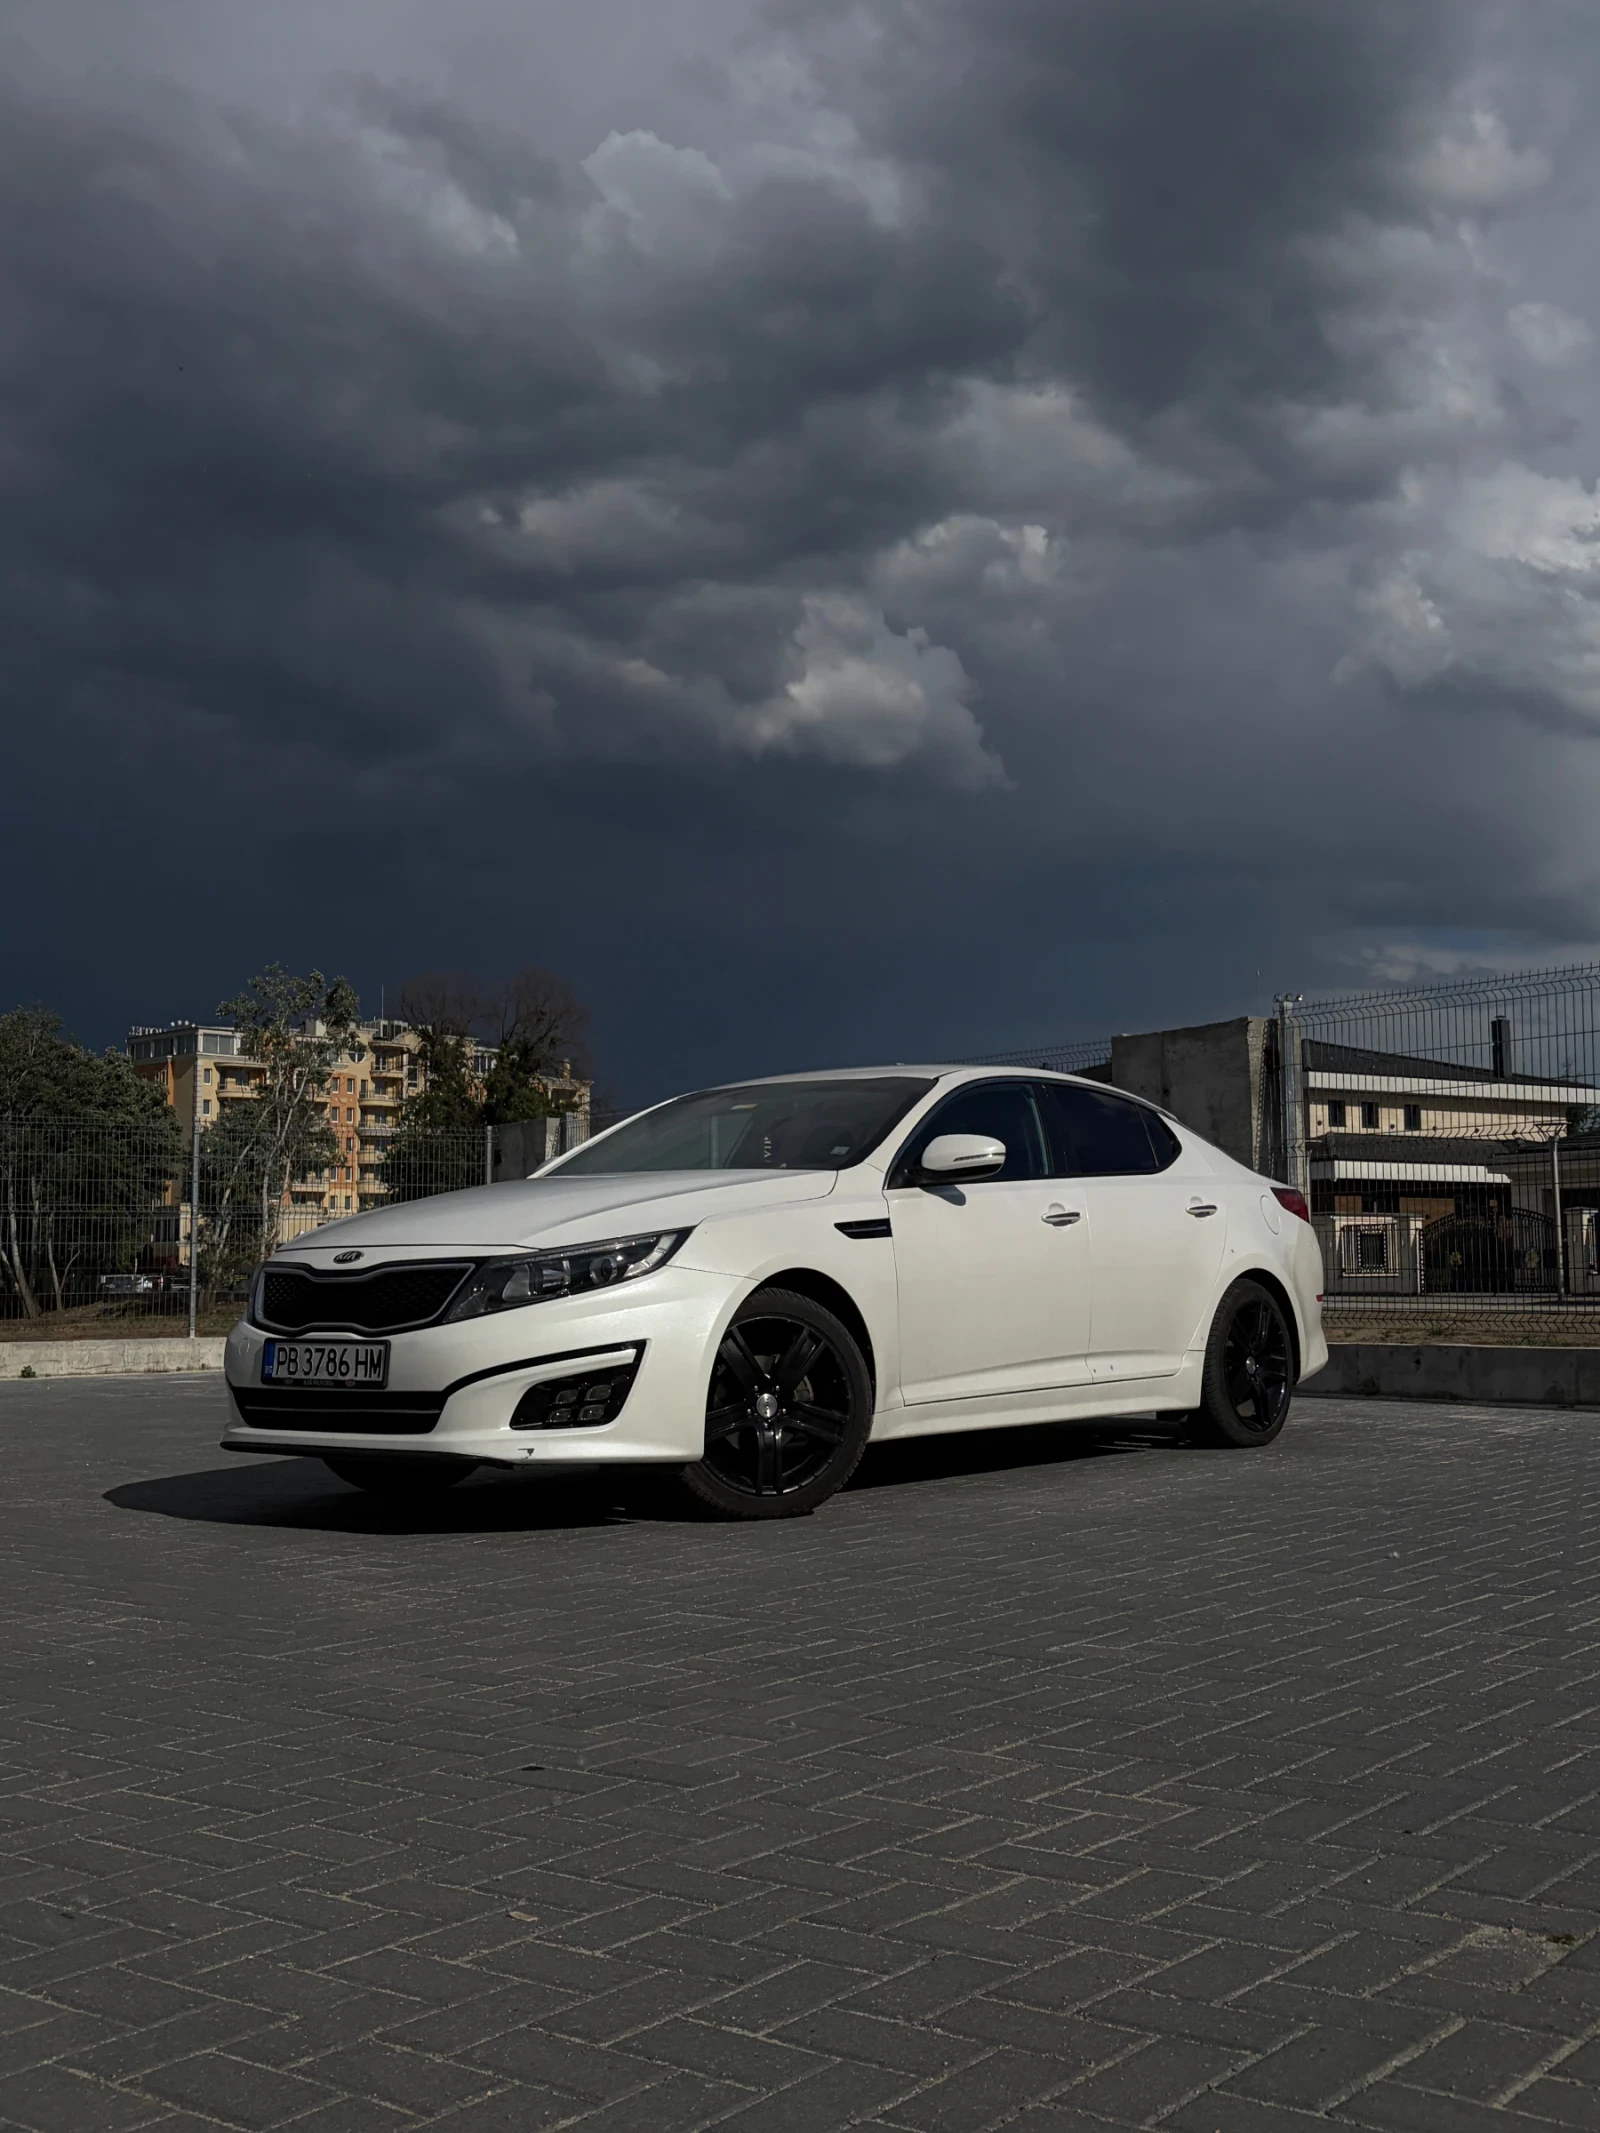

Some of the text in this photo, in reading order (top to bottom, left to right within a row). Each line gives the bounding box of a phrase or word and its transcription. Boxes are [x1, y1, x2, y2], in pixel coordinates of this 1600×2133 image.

[764, 1136, 772, 1158] VIP
[335, 1251, 359, 1261] KIA
[275, 1347, 383, 1378] PB 3786 HM
